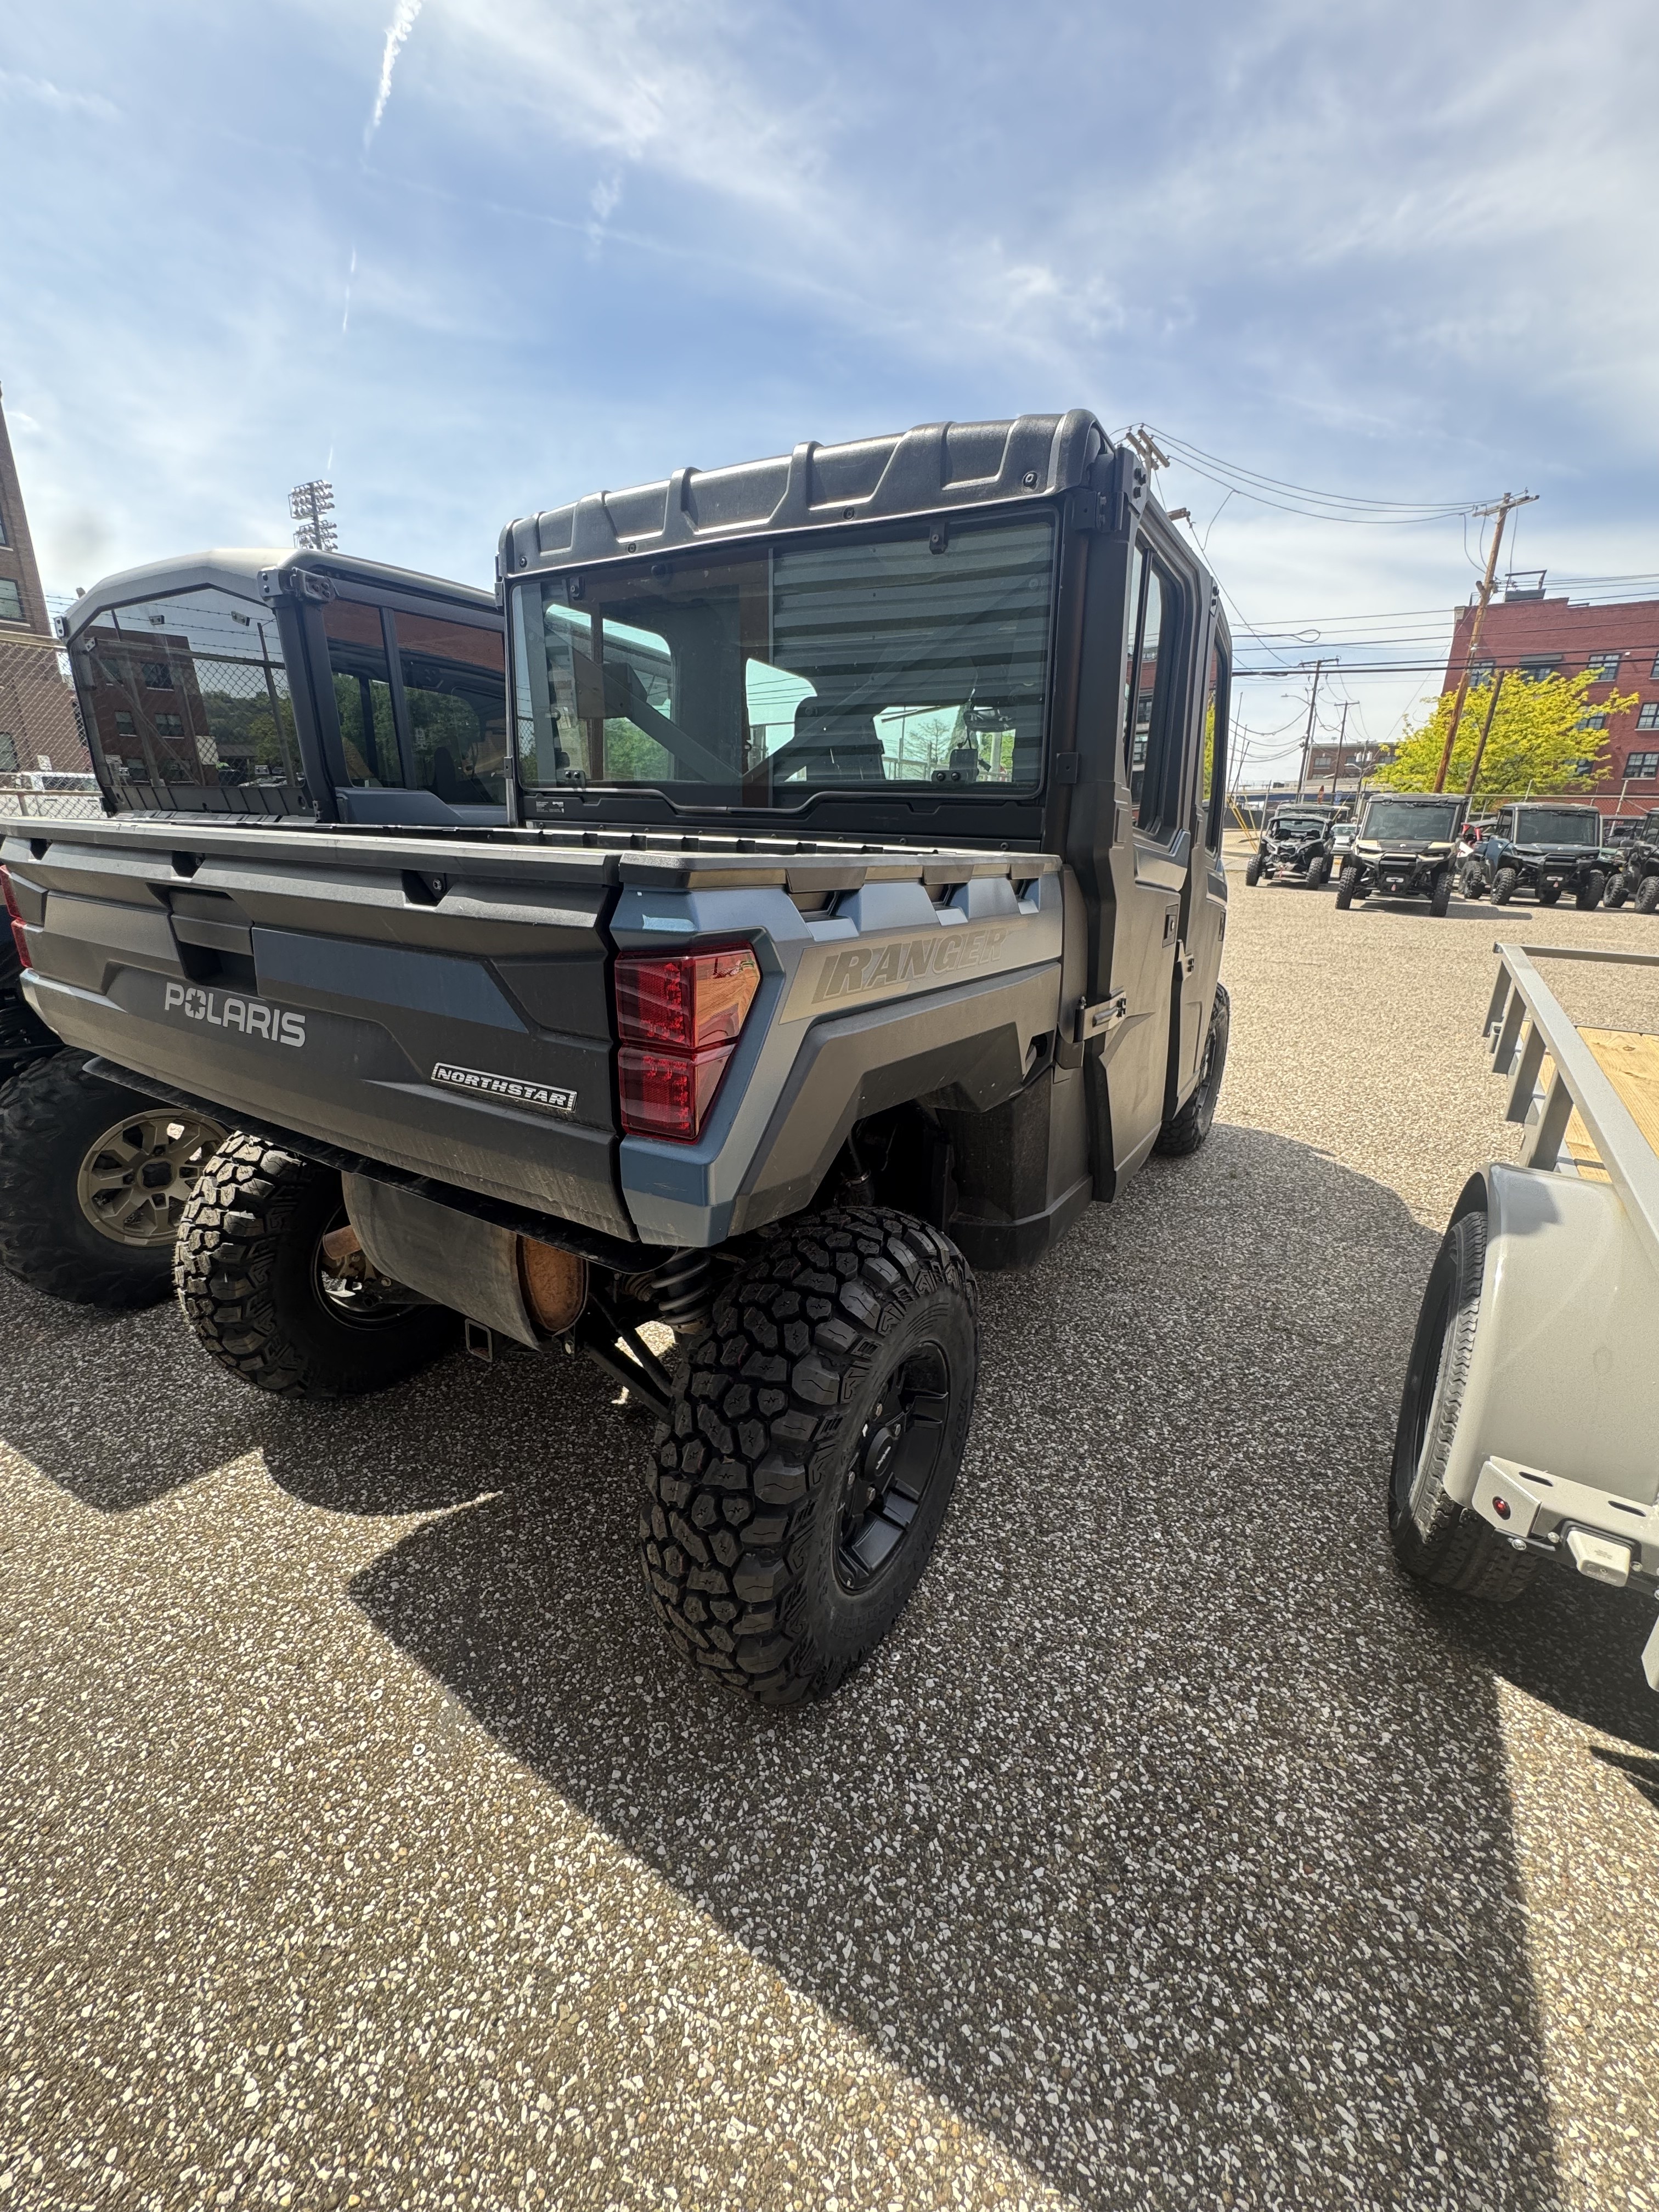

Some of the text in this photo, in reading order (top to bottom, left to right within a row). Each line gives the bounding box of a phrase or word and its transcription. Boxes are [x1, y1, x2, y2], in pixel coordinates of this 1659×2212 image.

[821, 927, 1008, 1000] RANGER
[165, 981, 306, 1048] POLARIS
[437, 1068, 567, 1106] NORTHSTAR
